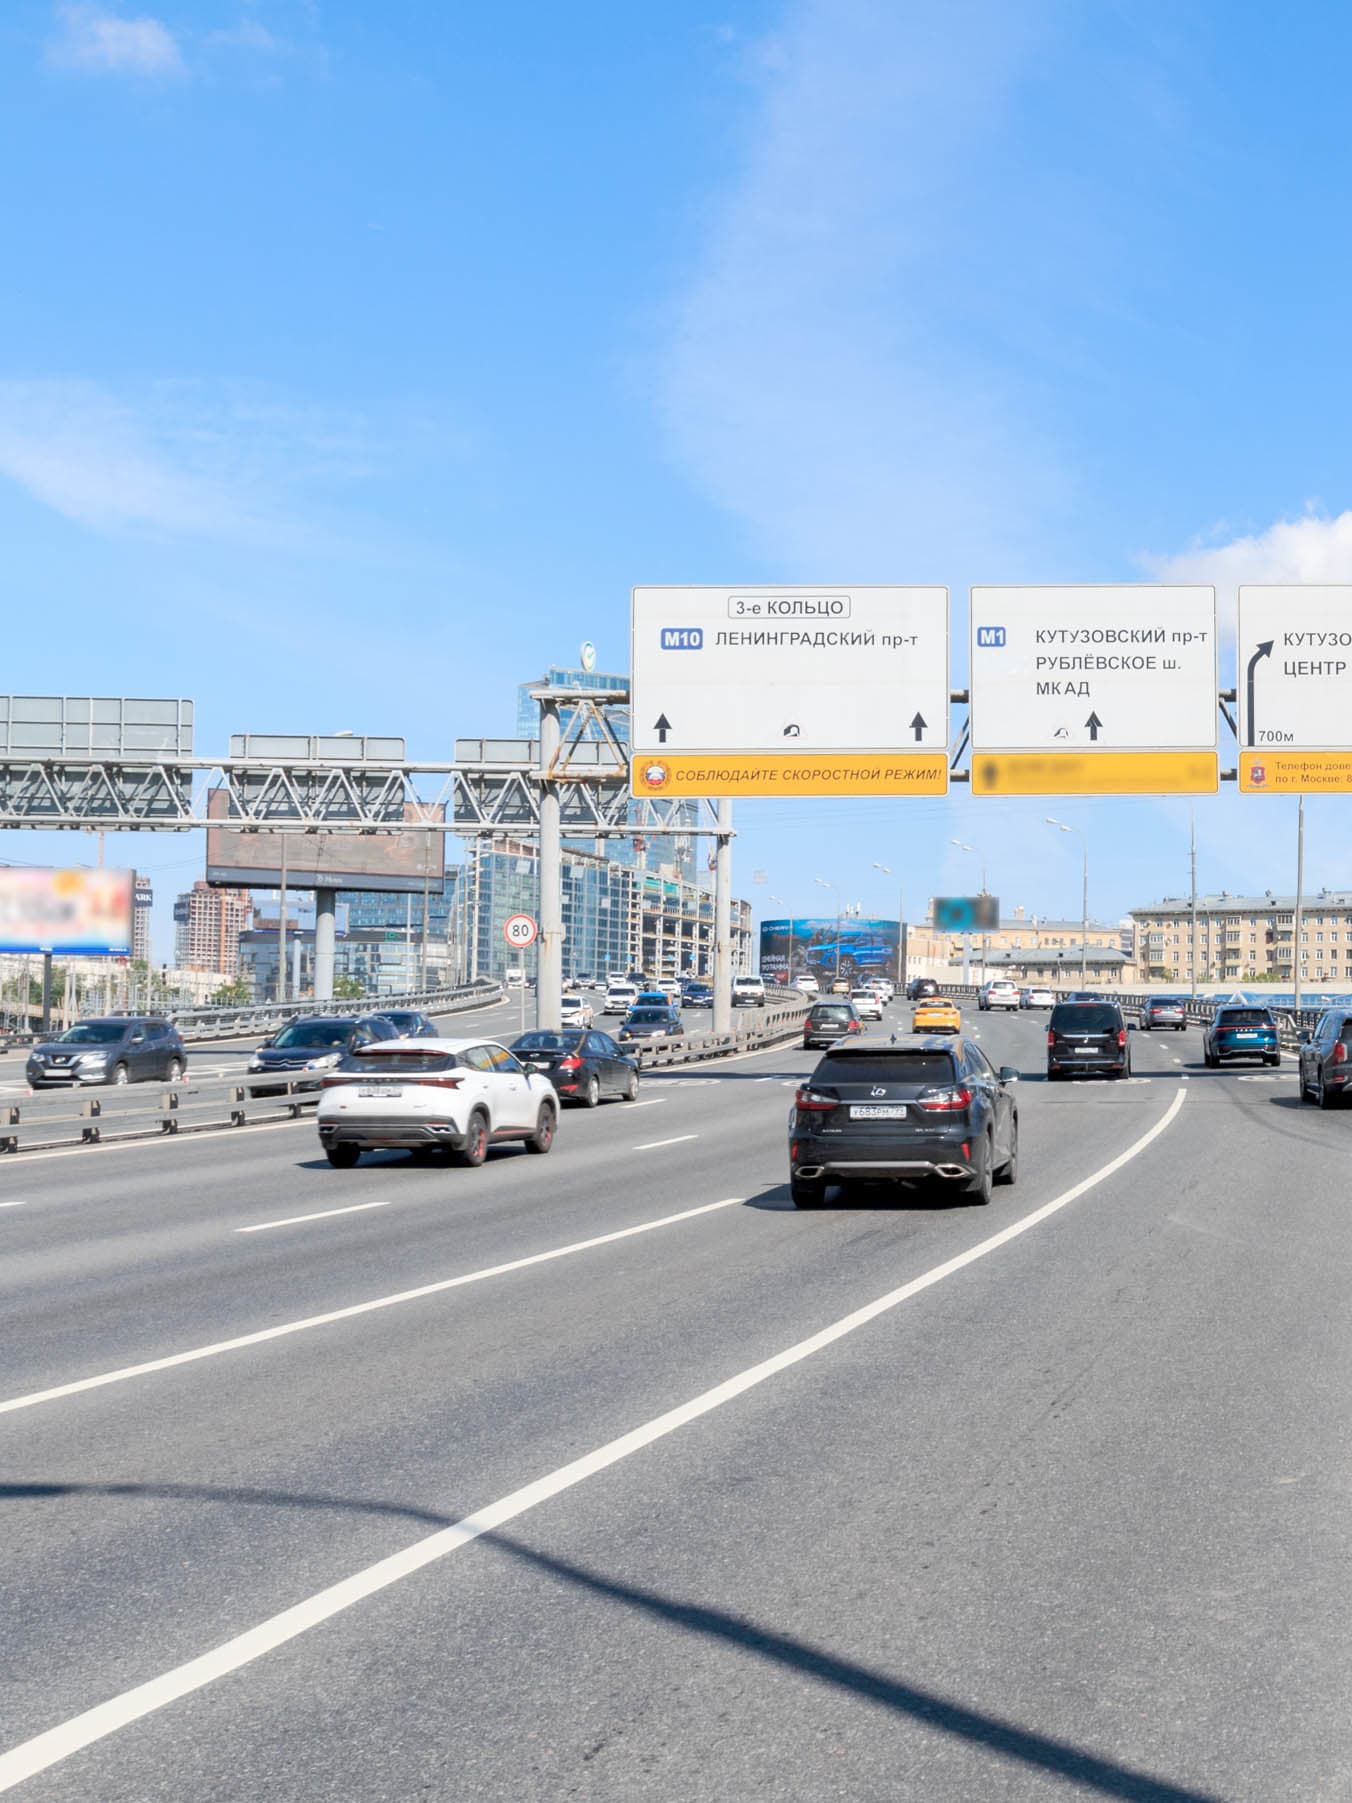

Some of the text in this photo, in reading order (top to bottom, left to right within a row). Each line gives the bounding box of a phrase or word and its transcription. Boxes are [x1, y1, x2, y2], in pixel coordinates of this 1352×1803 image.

[736, 600, 844, 617] 3-е КОЛЬЦО
[715, 628, 919, 649] ЛЕНИНГРАДСКИЙ пр-т
[1036, 626, 1208, 646] КУТУЗОВСКИЙ пр-т
[1036, 653, 1181, 670] РУБЛЁВСКОЕ ш.
[1284, 660, 1347, 679] ЦЕНТР
[1036, 681, 1091, 698] МКАД
[1258, 730, 1295, 743] 700м
[675, 764, 942, 784] СОБЛЮДАЙТЕ СКОРОСТНОЙ РЕЖИМ!
[1275, 761, 1322, 771] Телефон
[1275, 775, 1289, 784] по
[512, 924, 529, 937] 80
